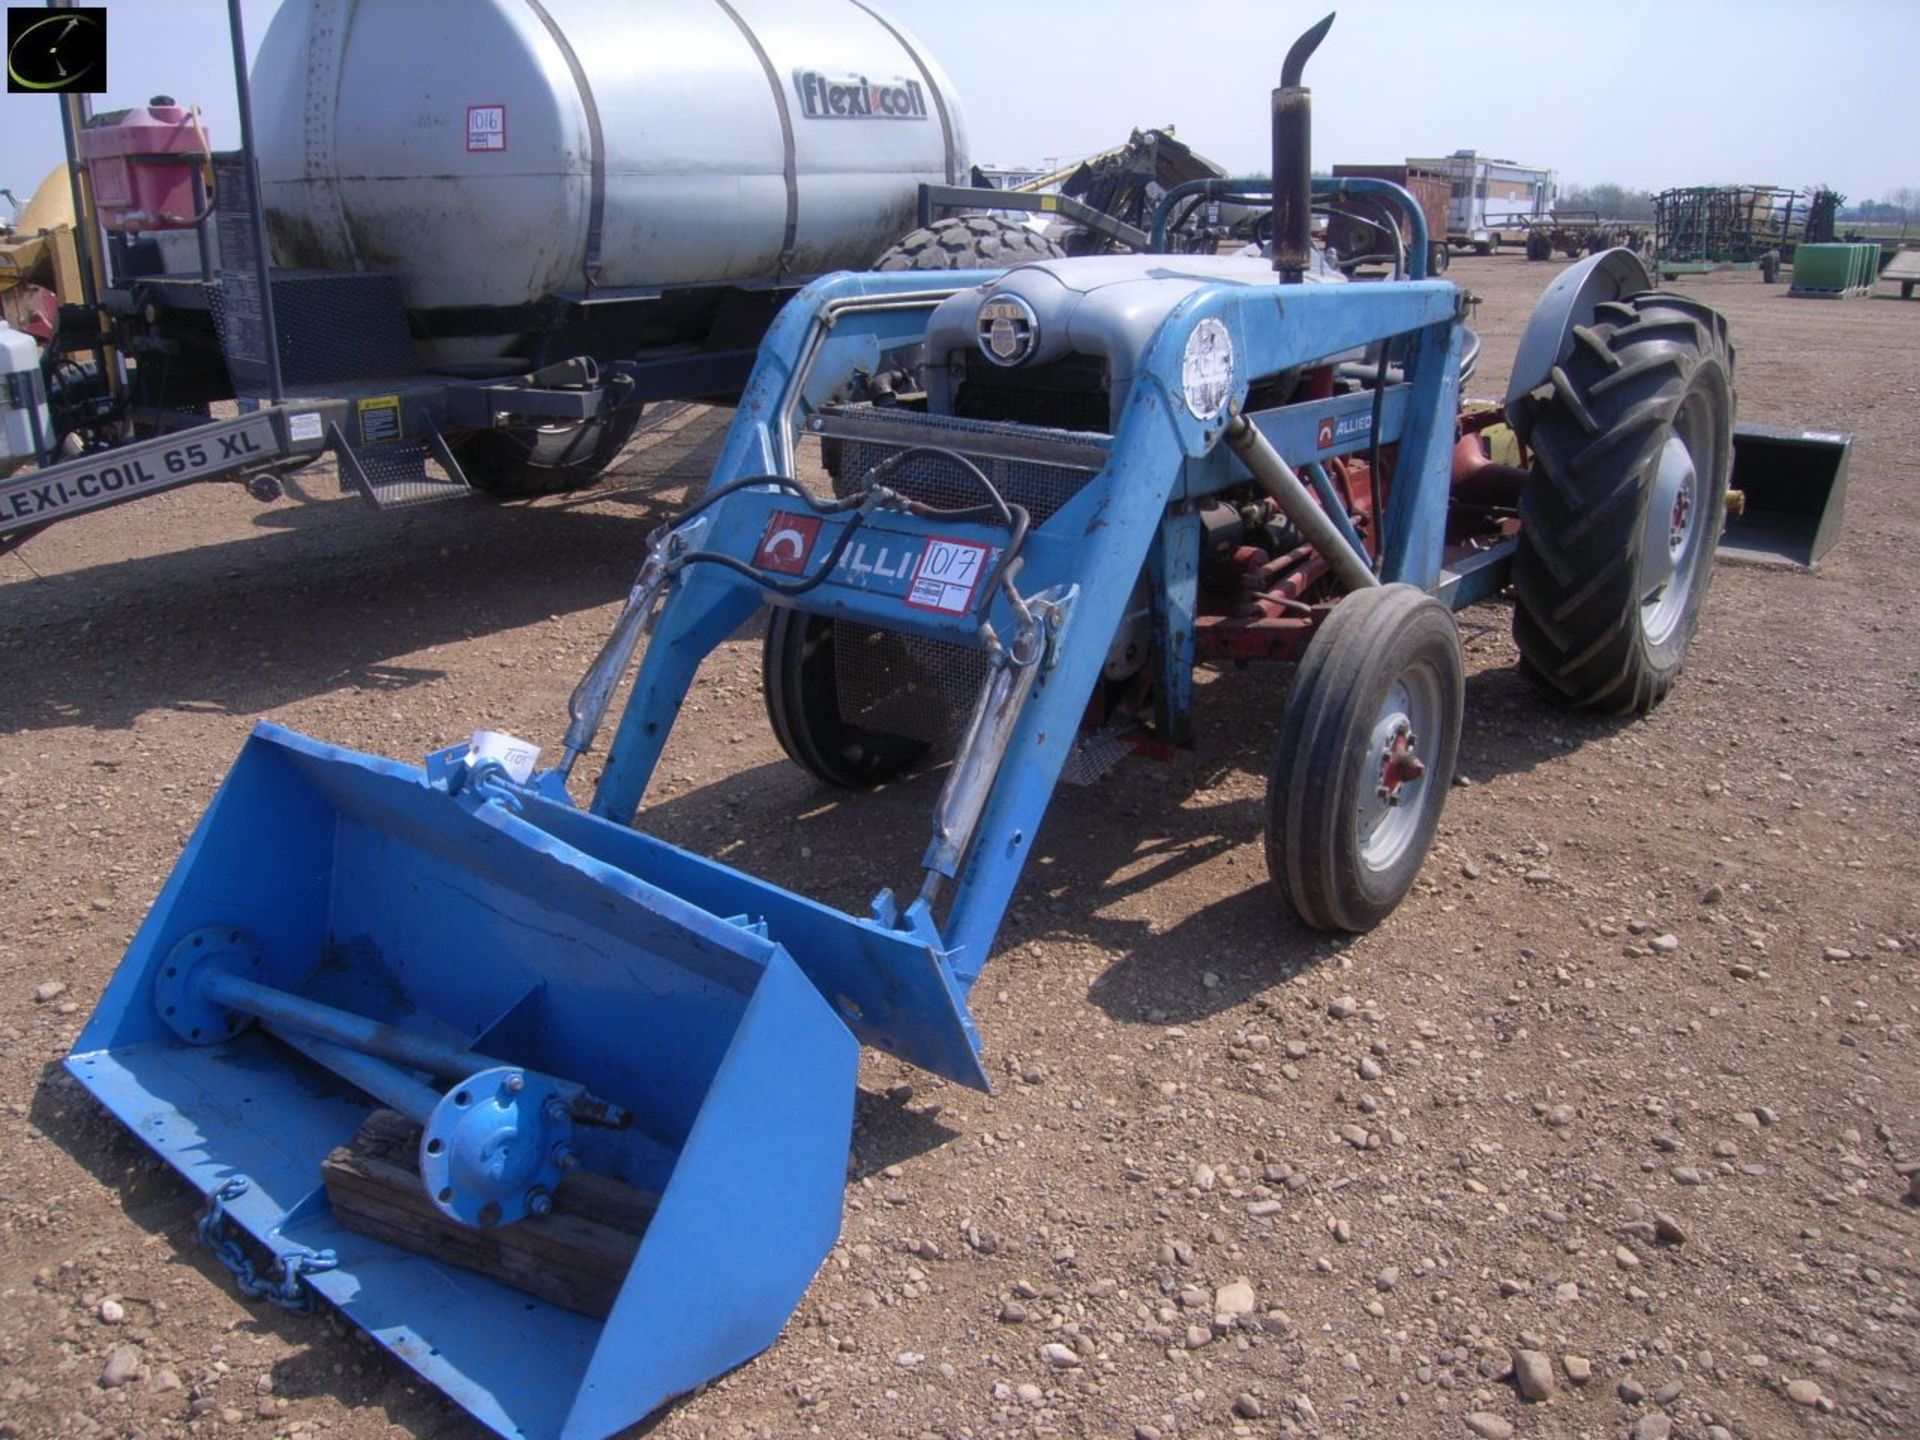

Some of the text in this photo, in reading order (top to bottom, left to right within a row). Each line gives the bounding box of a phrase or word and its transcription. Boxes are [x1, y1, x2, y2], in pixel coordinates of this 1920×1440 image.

[470, 110, 498, 130] 1016
[1335, 415, 1372, 436] ALLIED
[163, 444, 207, 474] 65
[217, 431, 261, 460] XL
[922, 544, 977, 580] 1017
